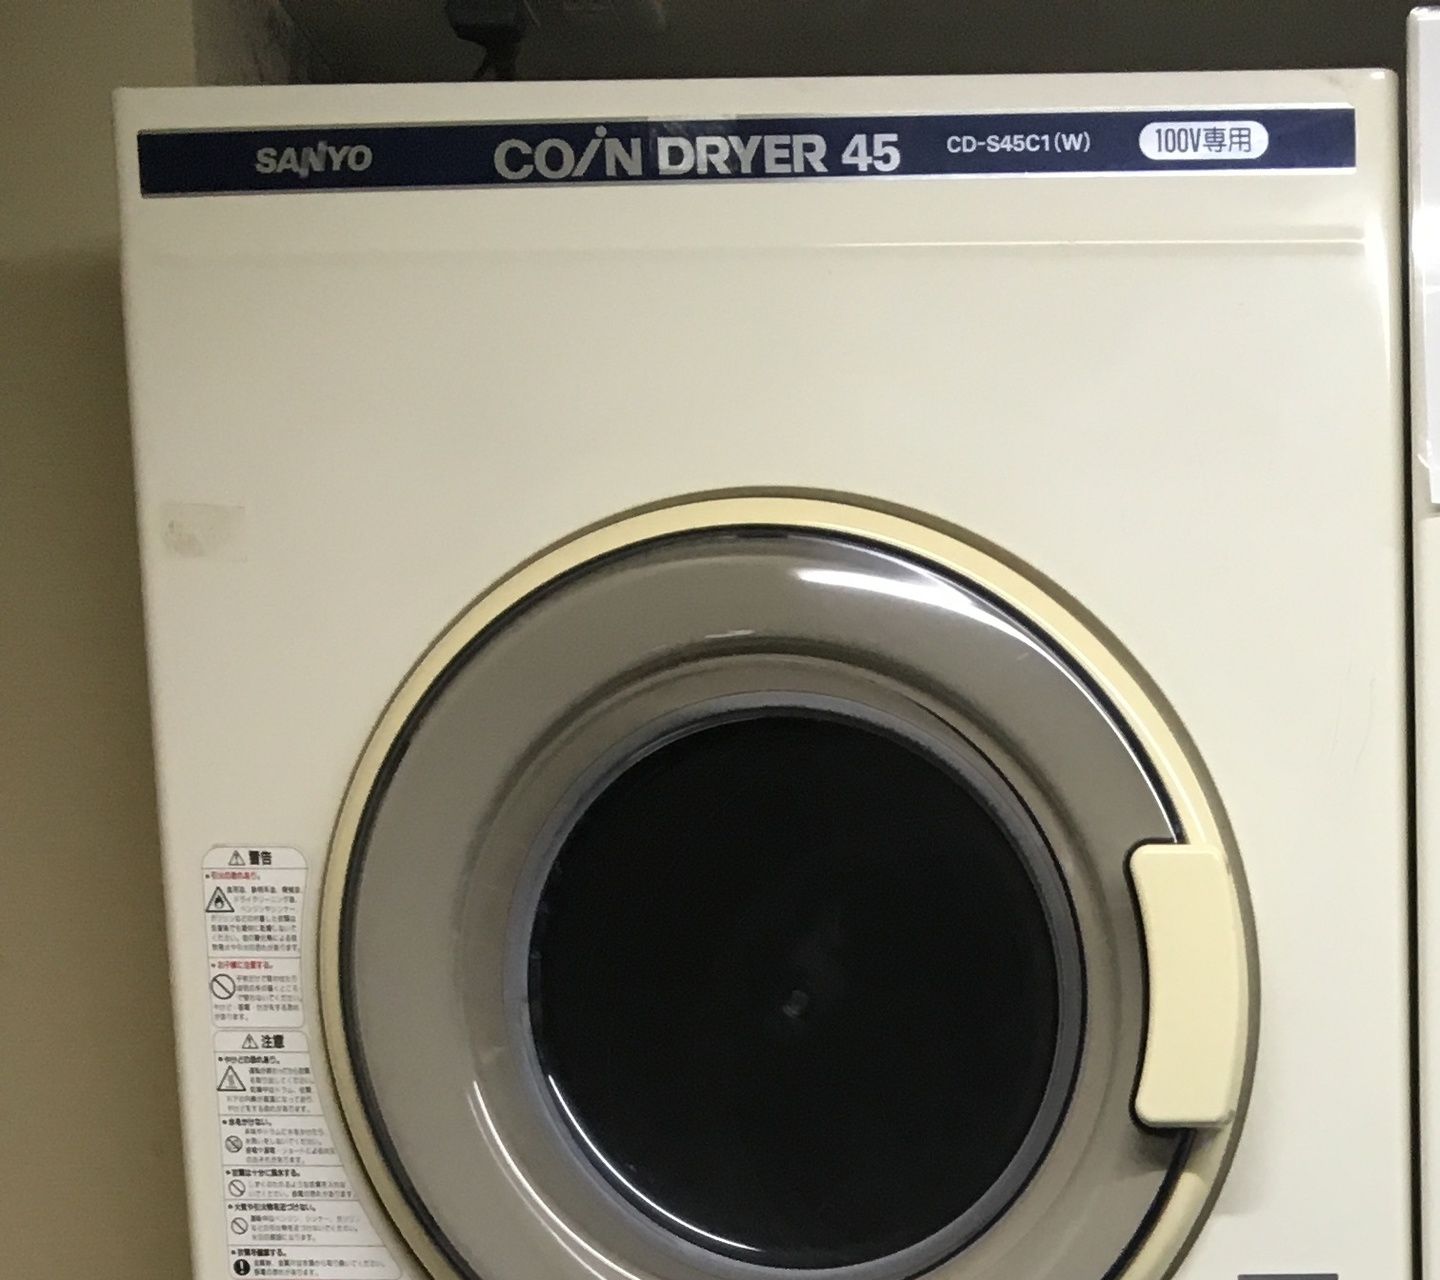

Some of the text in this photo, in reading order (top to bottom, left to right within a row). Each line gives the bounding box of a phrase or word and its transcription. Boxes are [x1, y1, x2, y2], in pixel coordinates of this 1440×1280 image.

[255, 141, 372, 173] SANYO
[658, 133, 827, 174] DRYER
[841, 134, 900, 172] 45
[946, 130, 1092, 155] CD-S45C1(W)
[1154, 126, 1252, 156] 100V専用
[261, 1034, 285, 1049] 注意
